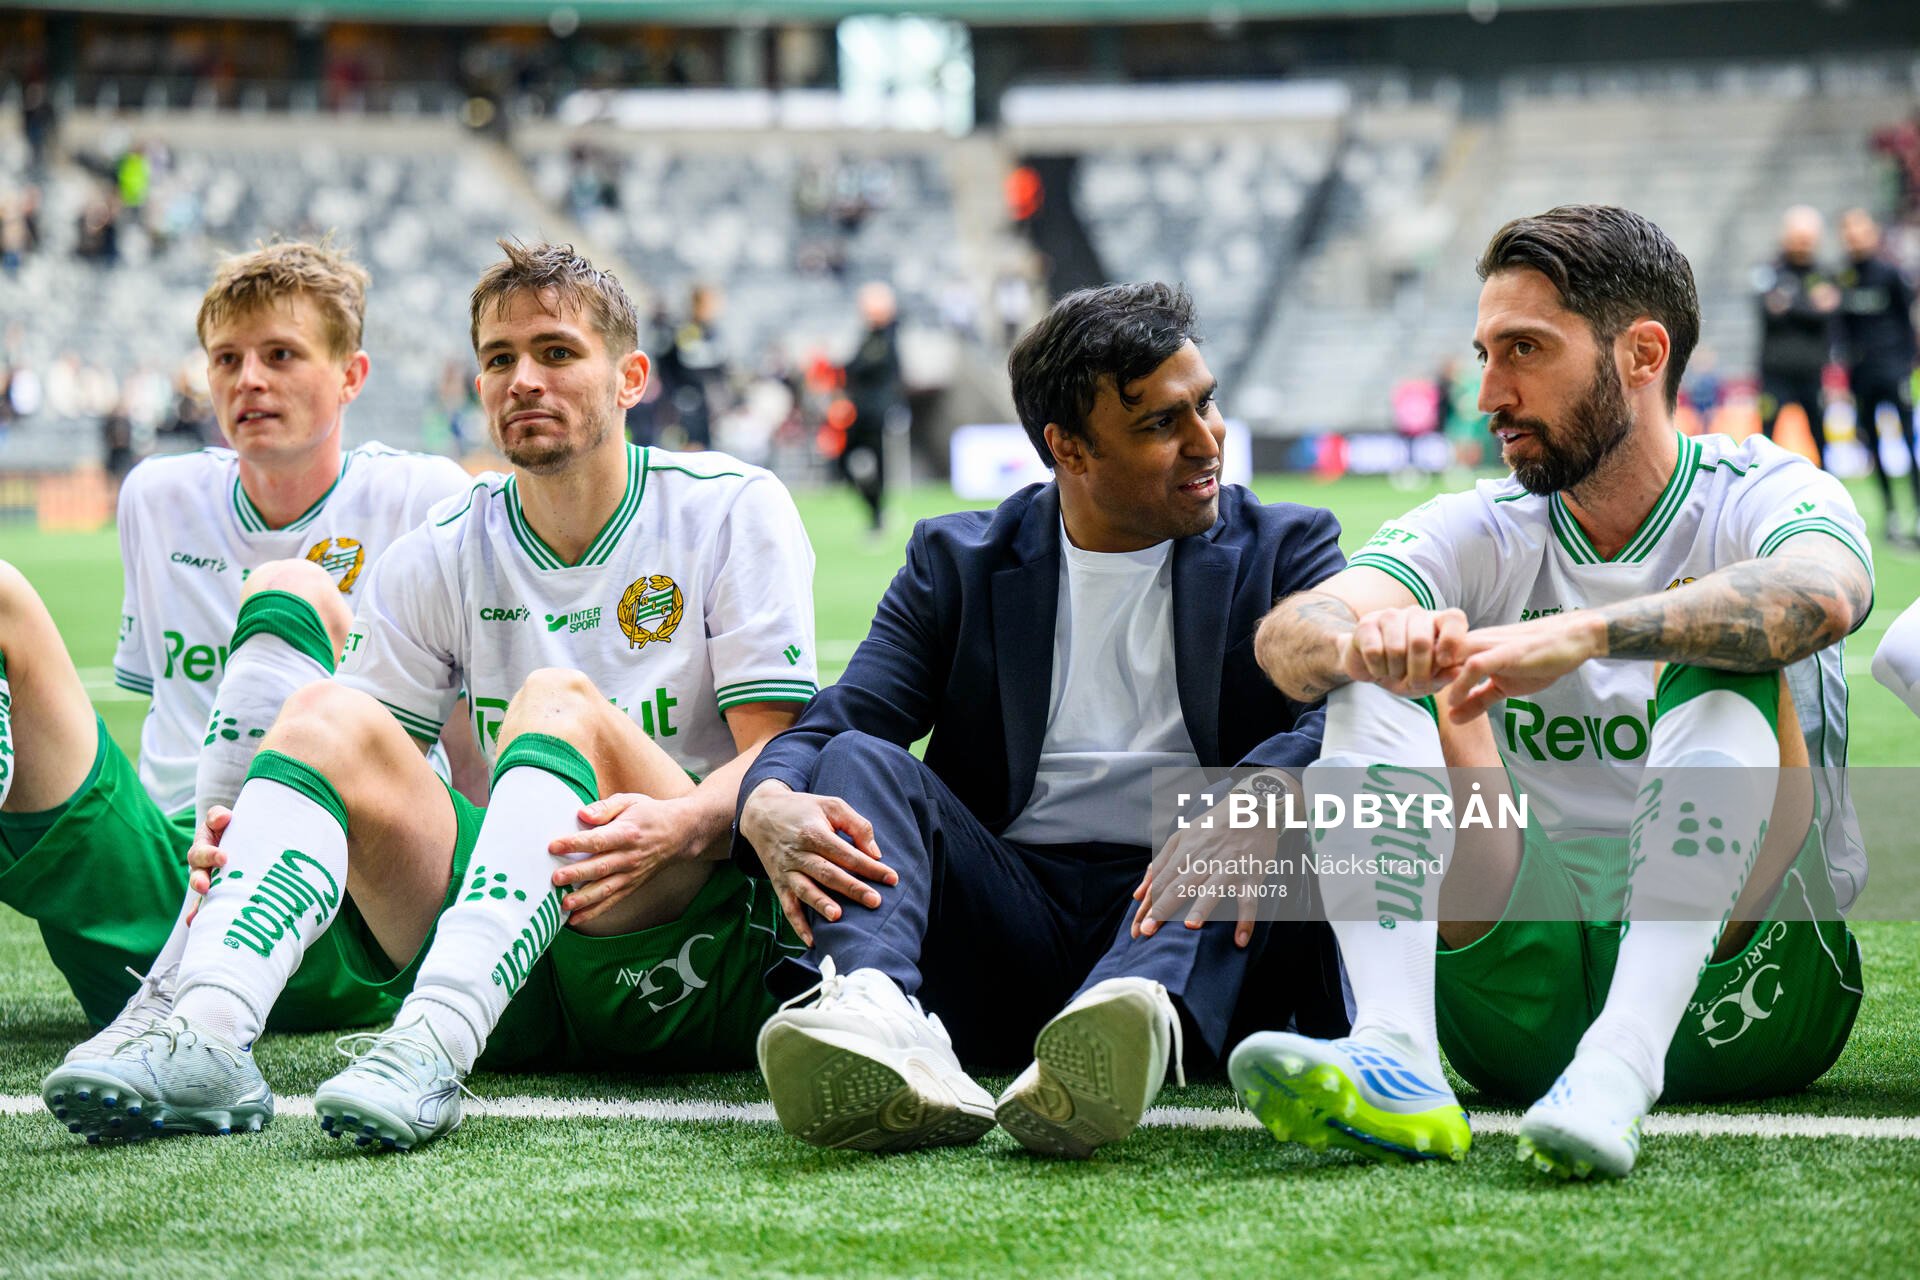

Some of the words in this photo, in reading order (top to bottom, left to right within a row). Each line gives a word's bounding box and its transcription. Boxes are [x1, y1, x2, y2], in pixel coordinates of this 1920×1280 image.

[170, 551, 218, 571] CRAFT
[570, 607, 602, 624] INTER
[1519, 608, 1561, 622] RAFT
[569, 617, 601, 634] SPORT
